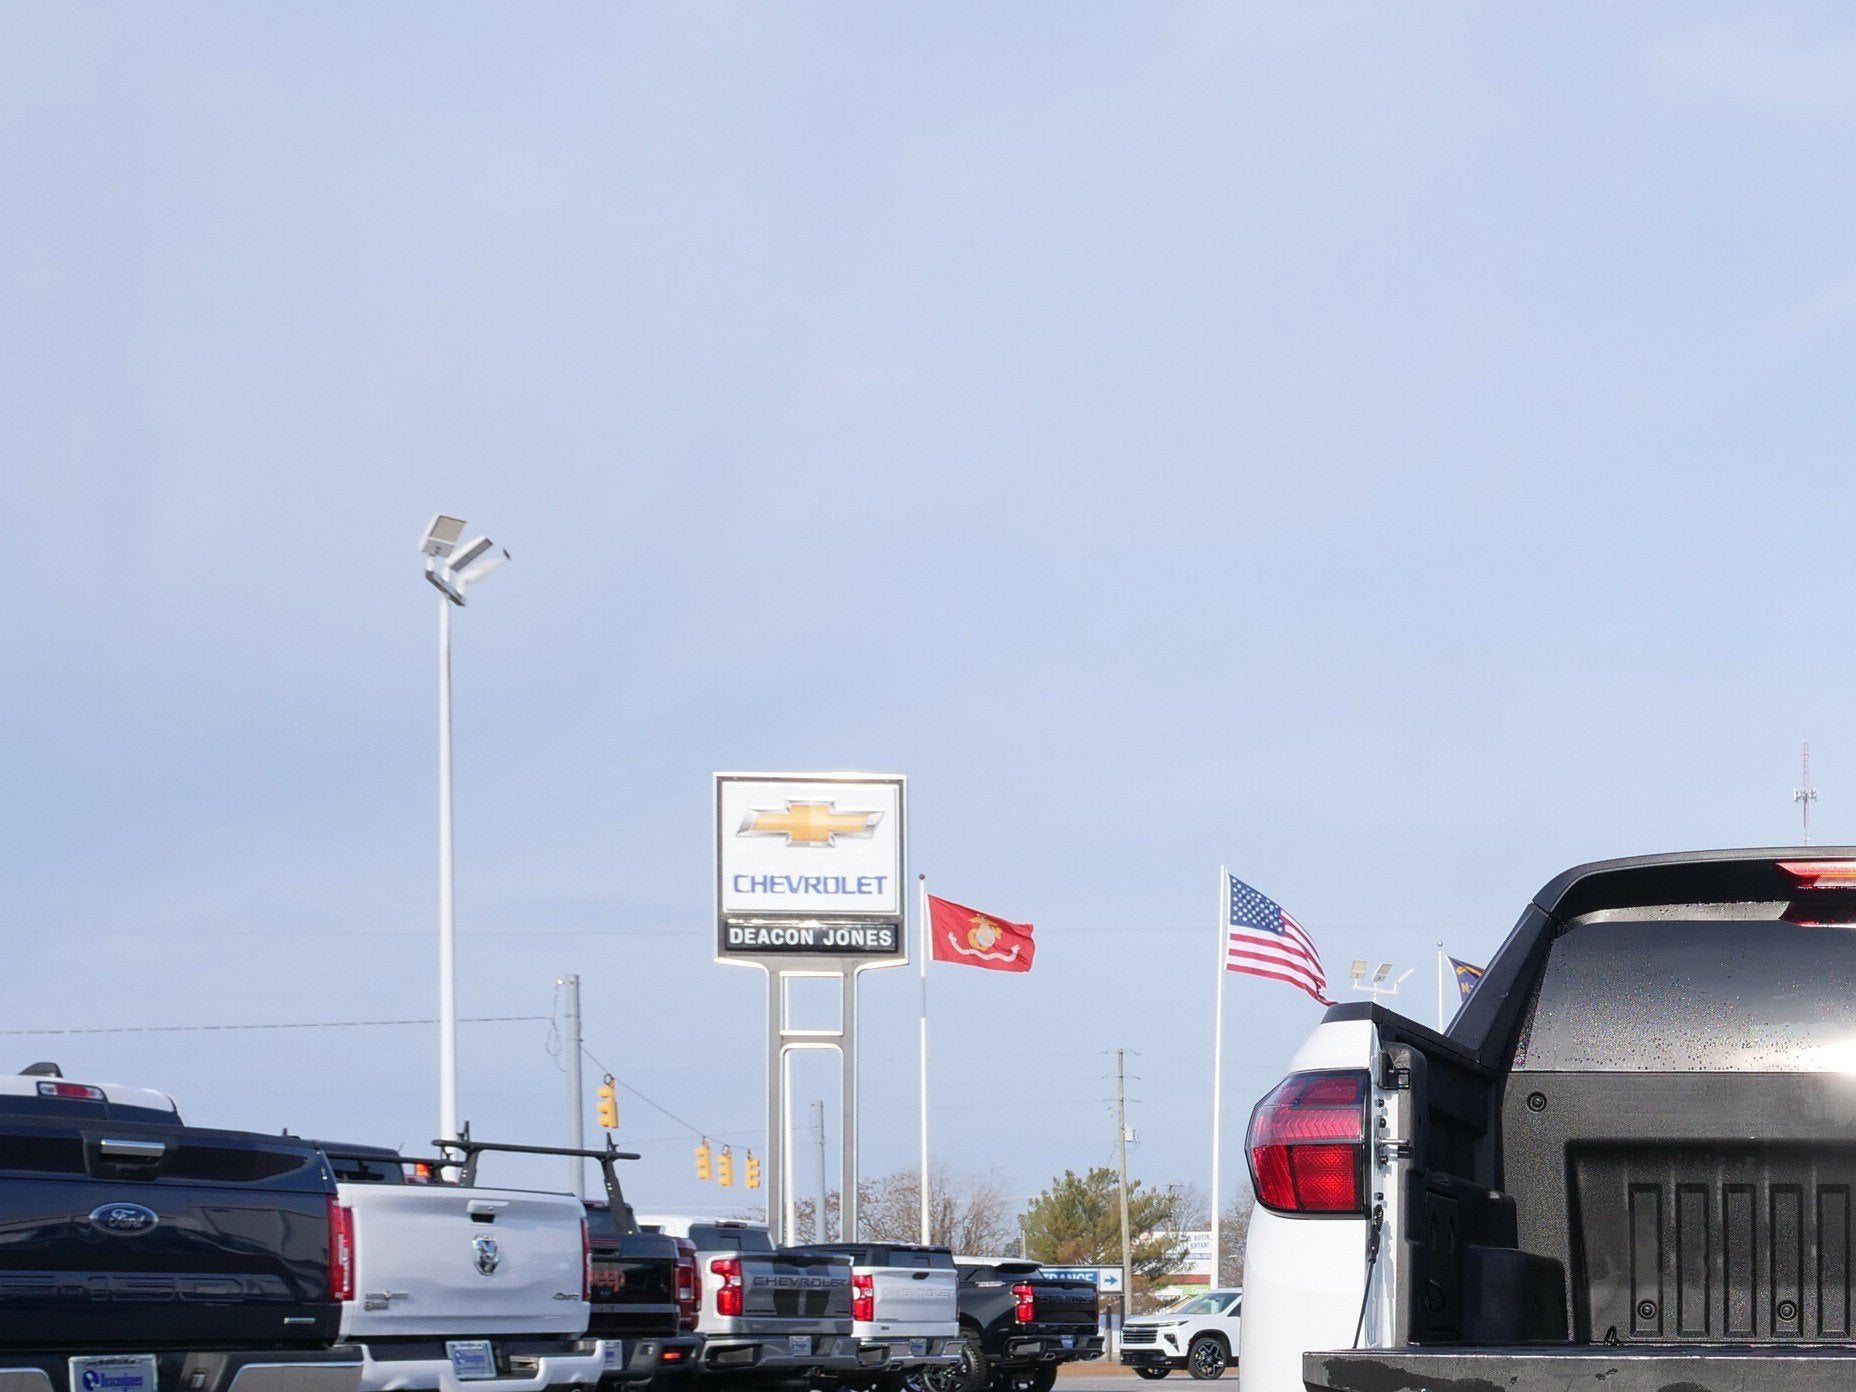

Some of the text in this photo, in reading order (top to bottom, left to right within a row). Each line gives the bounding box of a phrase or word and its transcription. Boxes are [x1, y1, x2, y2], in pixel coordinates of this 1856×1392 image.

[733, 874, 888, 895] CHEVROLET
[729, 928, 893, 946] DEACON JONES
[108, 1208, 146, 1228] Ford
[752, 1276, 848, 1288] CHEVROLET
